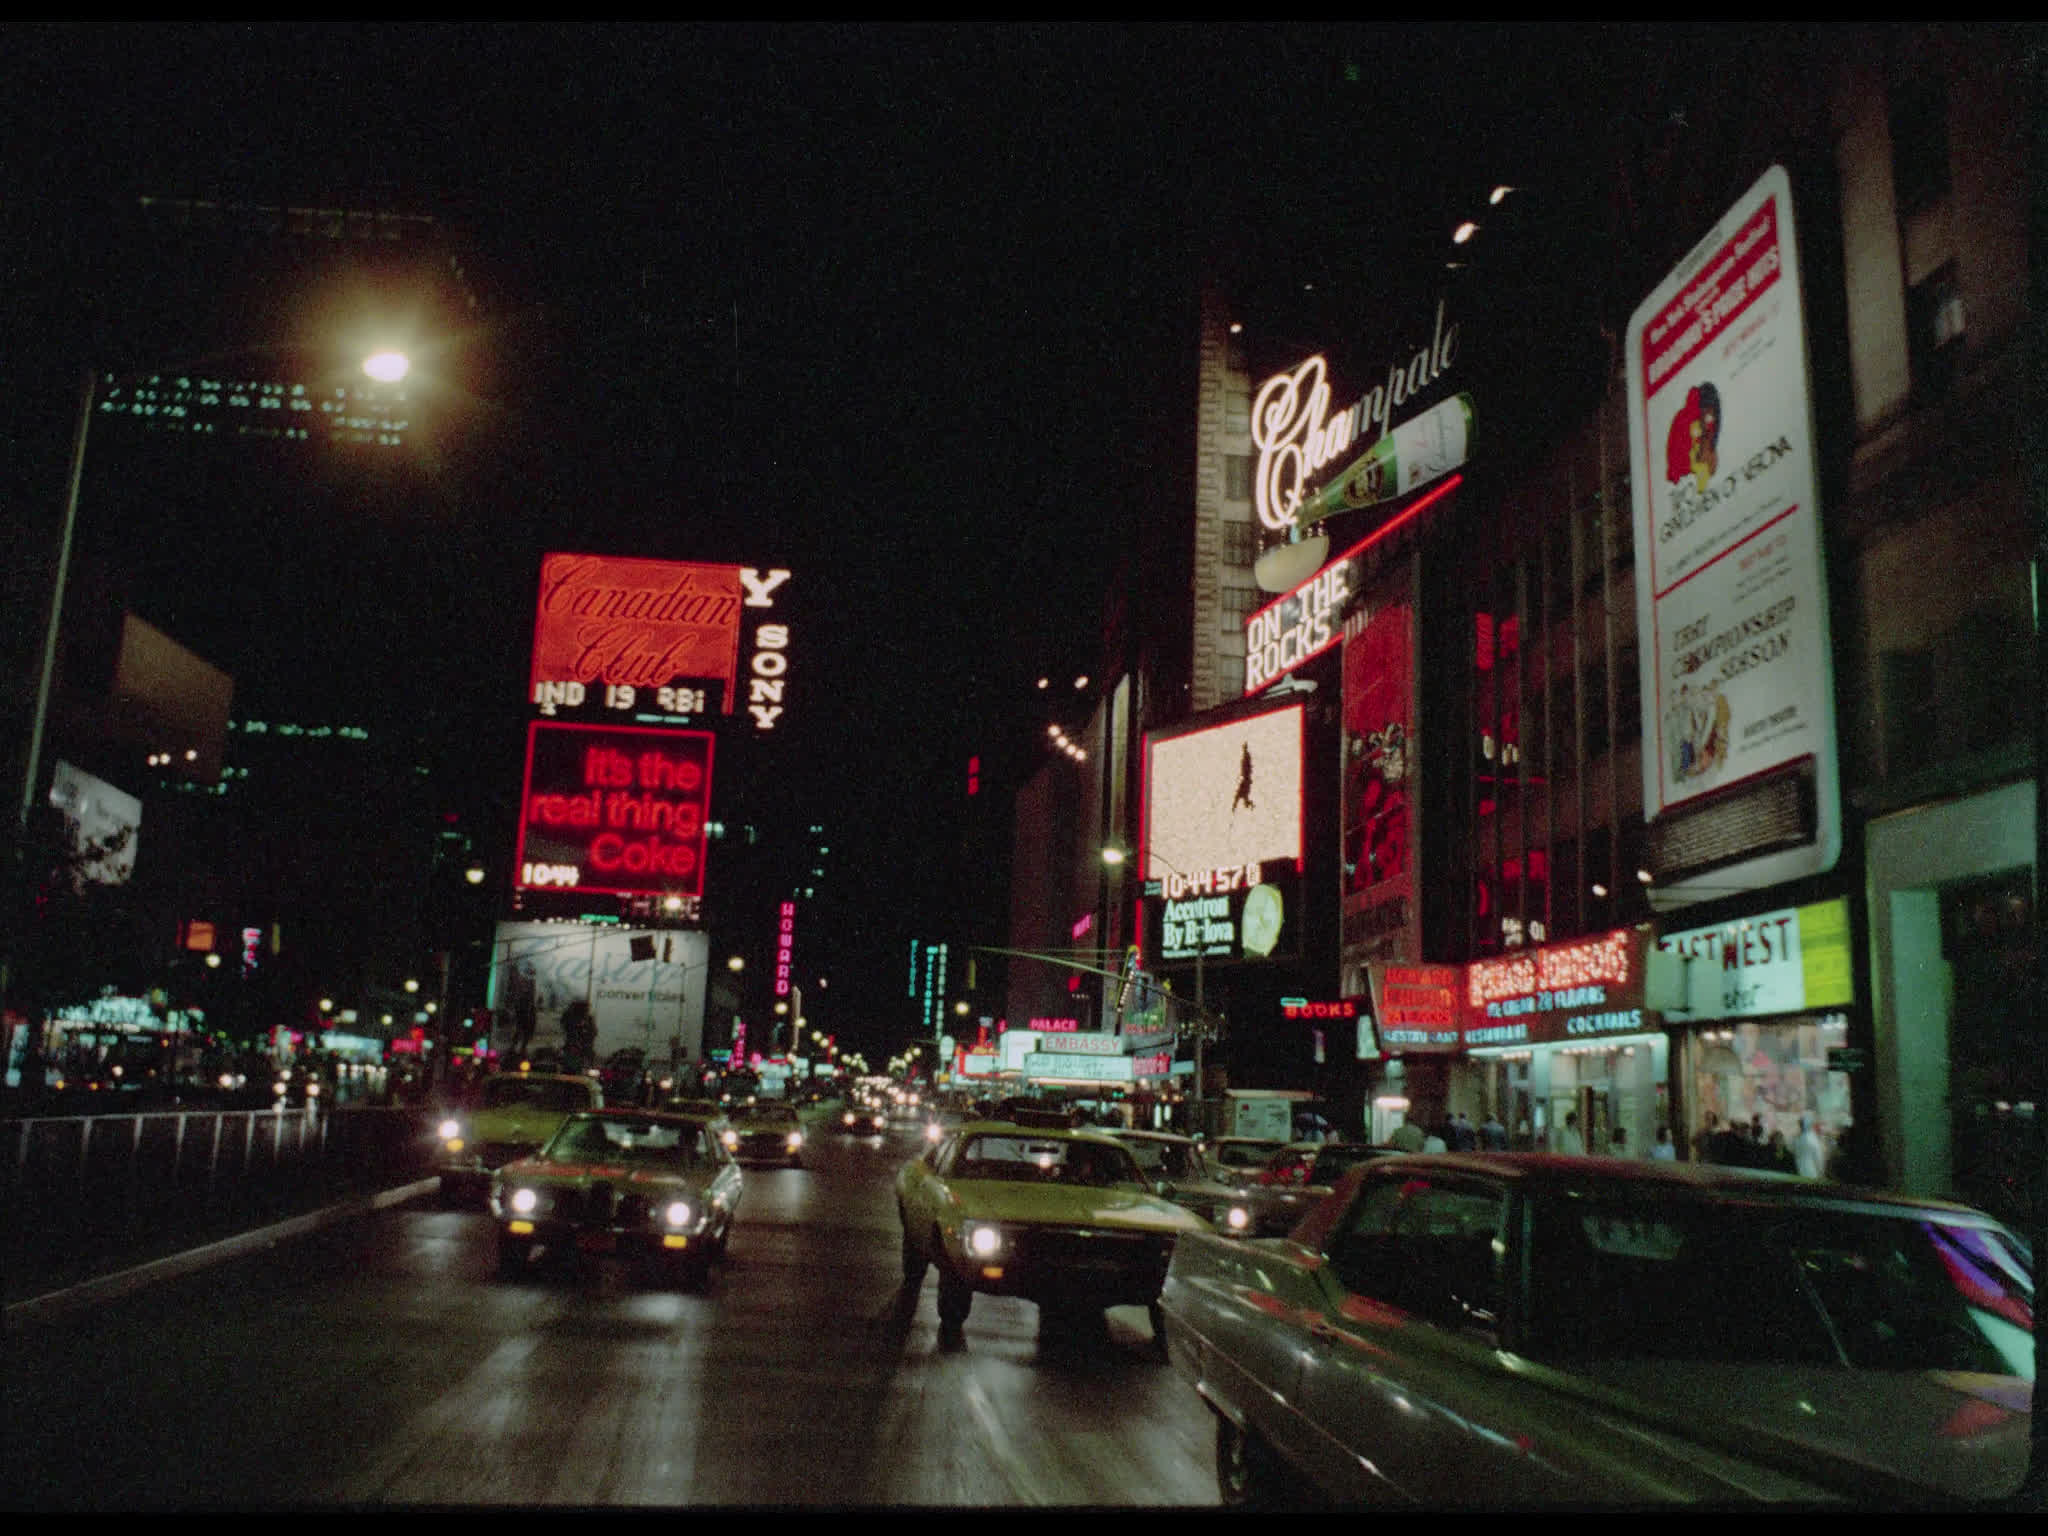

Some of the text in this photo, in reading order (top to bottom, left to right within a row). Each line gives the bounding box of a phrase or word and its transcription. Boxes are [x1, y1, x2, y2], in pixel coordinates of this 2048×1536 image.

[543, 556, 739, 625] Canadian
[739, 568, 792, 608] Y
[1246, 559, 1351, 655] ON THE
[574, 621, 700, 686] Club
[1245, 608, 1331, 695] ROCKS
[748, 624, 789, 729] SONY
[636, 751, 701, 791] the
[530, 790, 701, 841] real thing
[589, 832, 697, 875] Coke
[1163, 895, 1230, 922] Accutron
[776, 901, 797, 997] HOWARD
[1162, 920, 1184, 950] By
[1721, 916, 1791, 972] WEST
[1028, 1017, 1079, 1033] PALACE
[1285, 1002, 1355, 1019] BOOKS
[1567, 1009, 1642, 1034] COCKTAILS
[1045, 1035, 1122, 1051] EMBASSY
